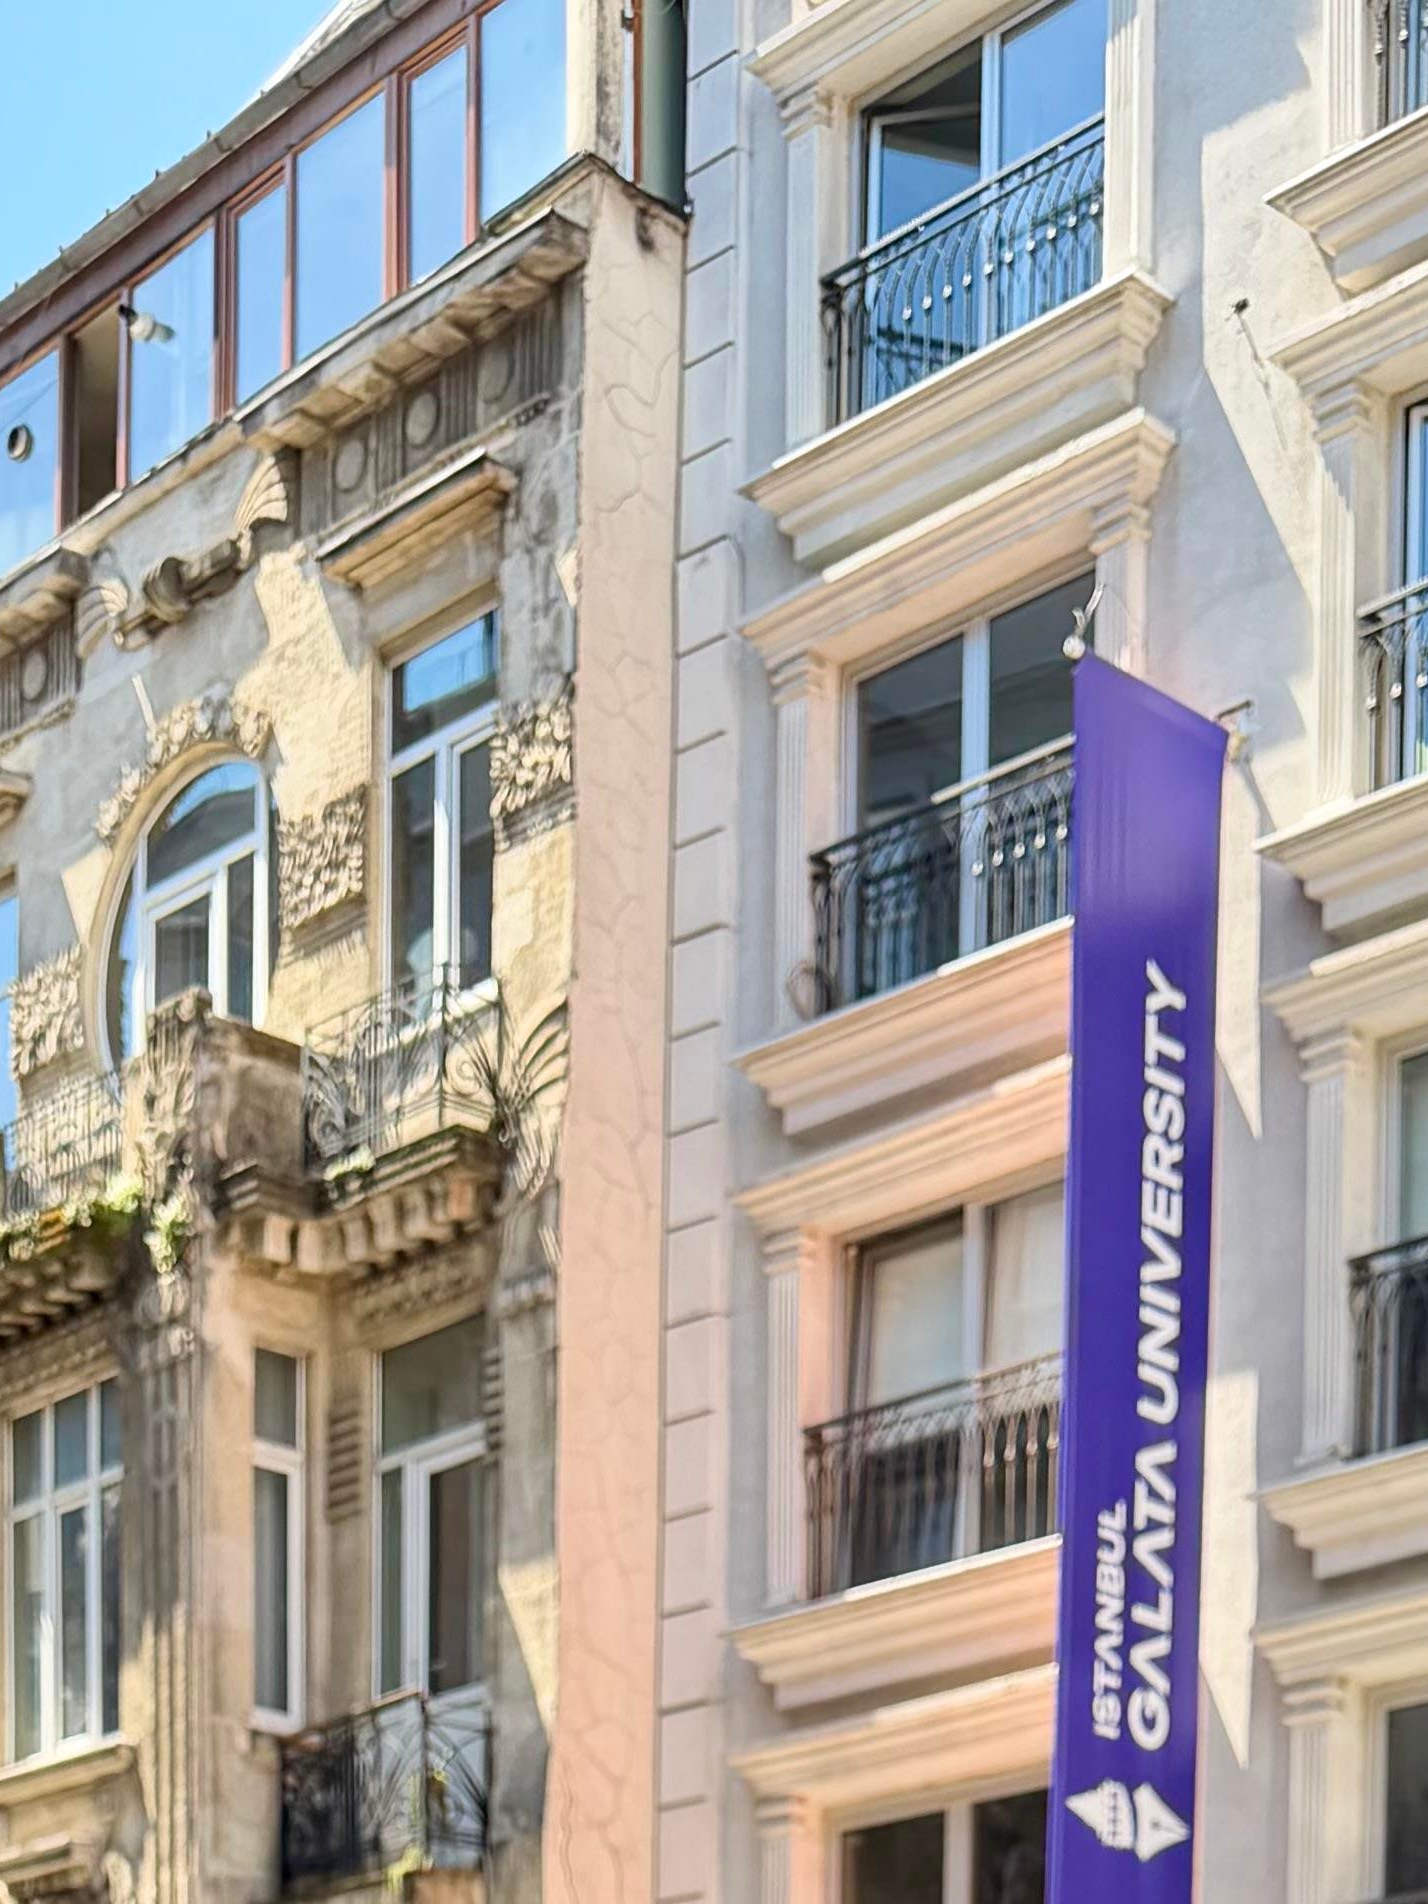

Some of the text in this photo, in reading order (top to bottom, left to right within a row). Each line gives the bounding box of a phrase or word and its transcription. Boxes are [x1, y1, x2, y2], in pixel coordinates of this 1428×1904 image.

[1128, 959, 1187, 1752] GALATA UNIVERSITY
[1091, 1500, 1127, 1741] ISTANBUL
